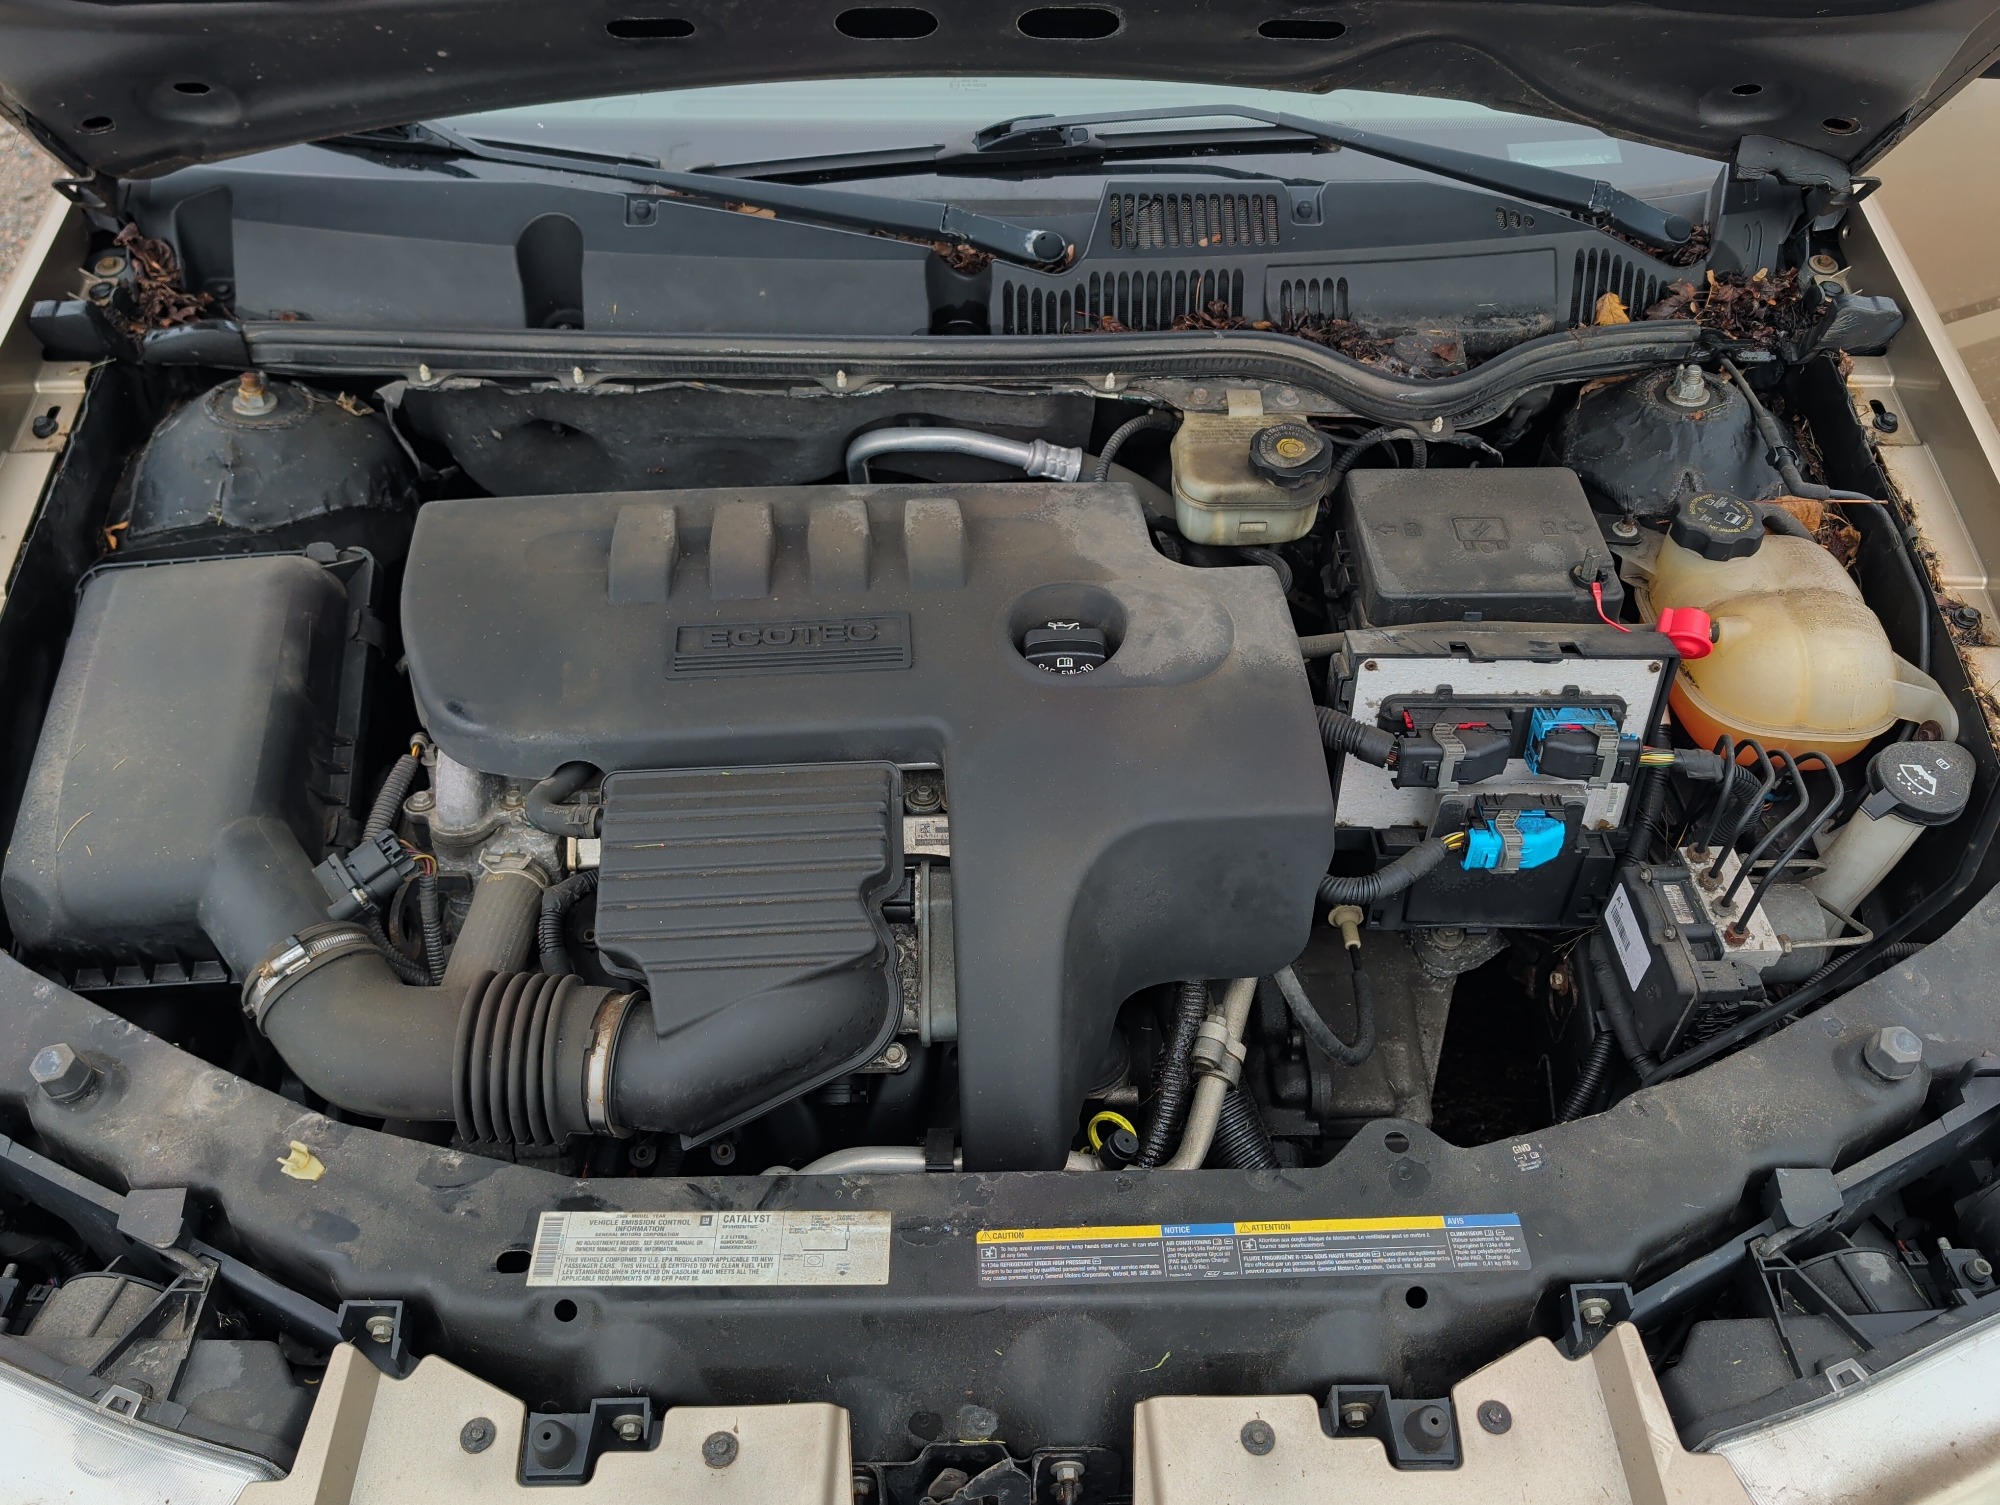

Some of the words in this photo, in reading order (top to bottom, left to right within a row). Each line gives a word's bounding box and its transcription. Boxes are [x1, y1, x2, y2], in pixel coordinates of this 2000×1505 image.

[703, 622, 878, 648] ECOTEC
[1512, 1143, 1532, 1154] GND
[724, 1215, 771, 1223] CATALYST
[1448, 1217, 1464, 1225] AVIS
[1164, 1226, 1190, 1234] NOTICE
[1252, 1223, 1290, 1231] ATTENTION
[992, 1232, 1024, 1240] CAUTION
